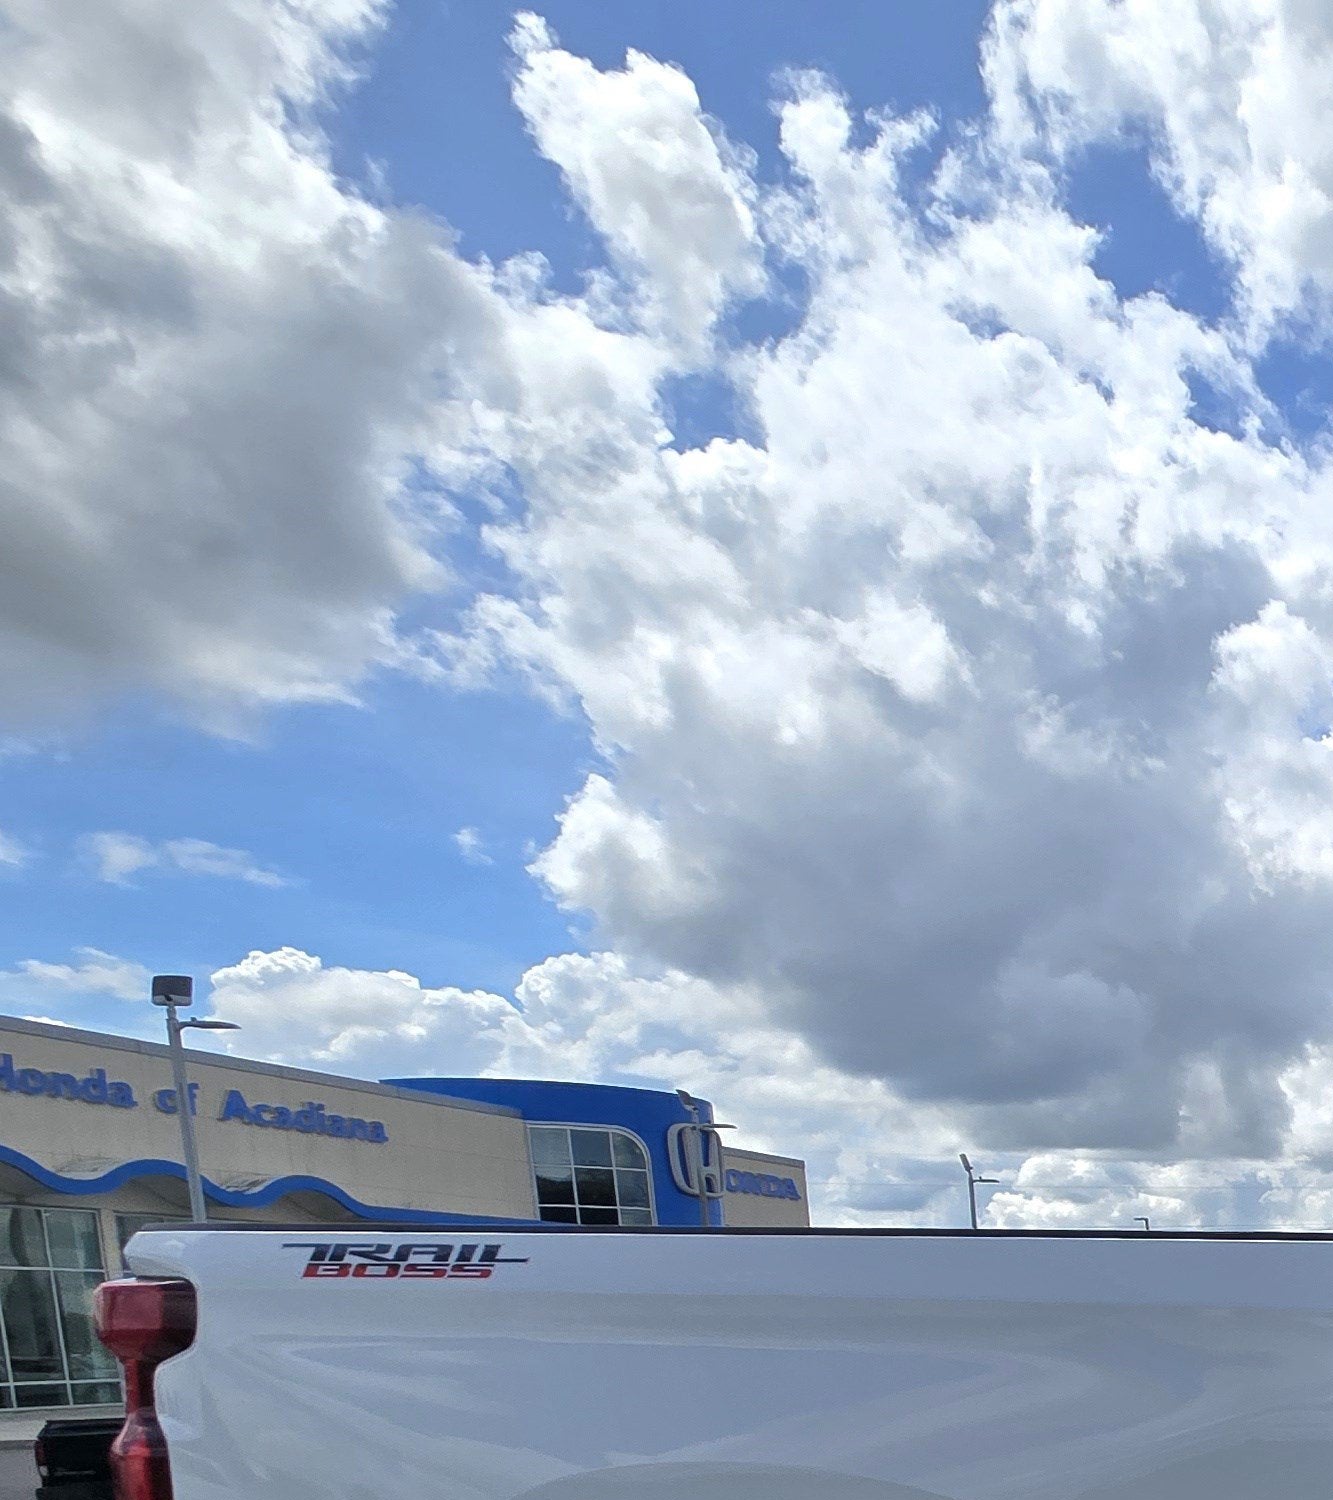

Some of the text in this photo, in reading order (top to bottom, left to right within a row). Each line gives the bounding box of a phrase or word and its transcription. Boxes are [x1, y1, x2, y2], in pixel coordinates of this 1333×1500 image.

[217, 1089, 390, 1144] Acadiana
[281, 1243, 530, 1263] TRAIL
[302, 1262, 495, 1279] BOSS
